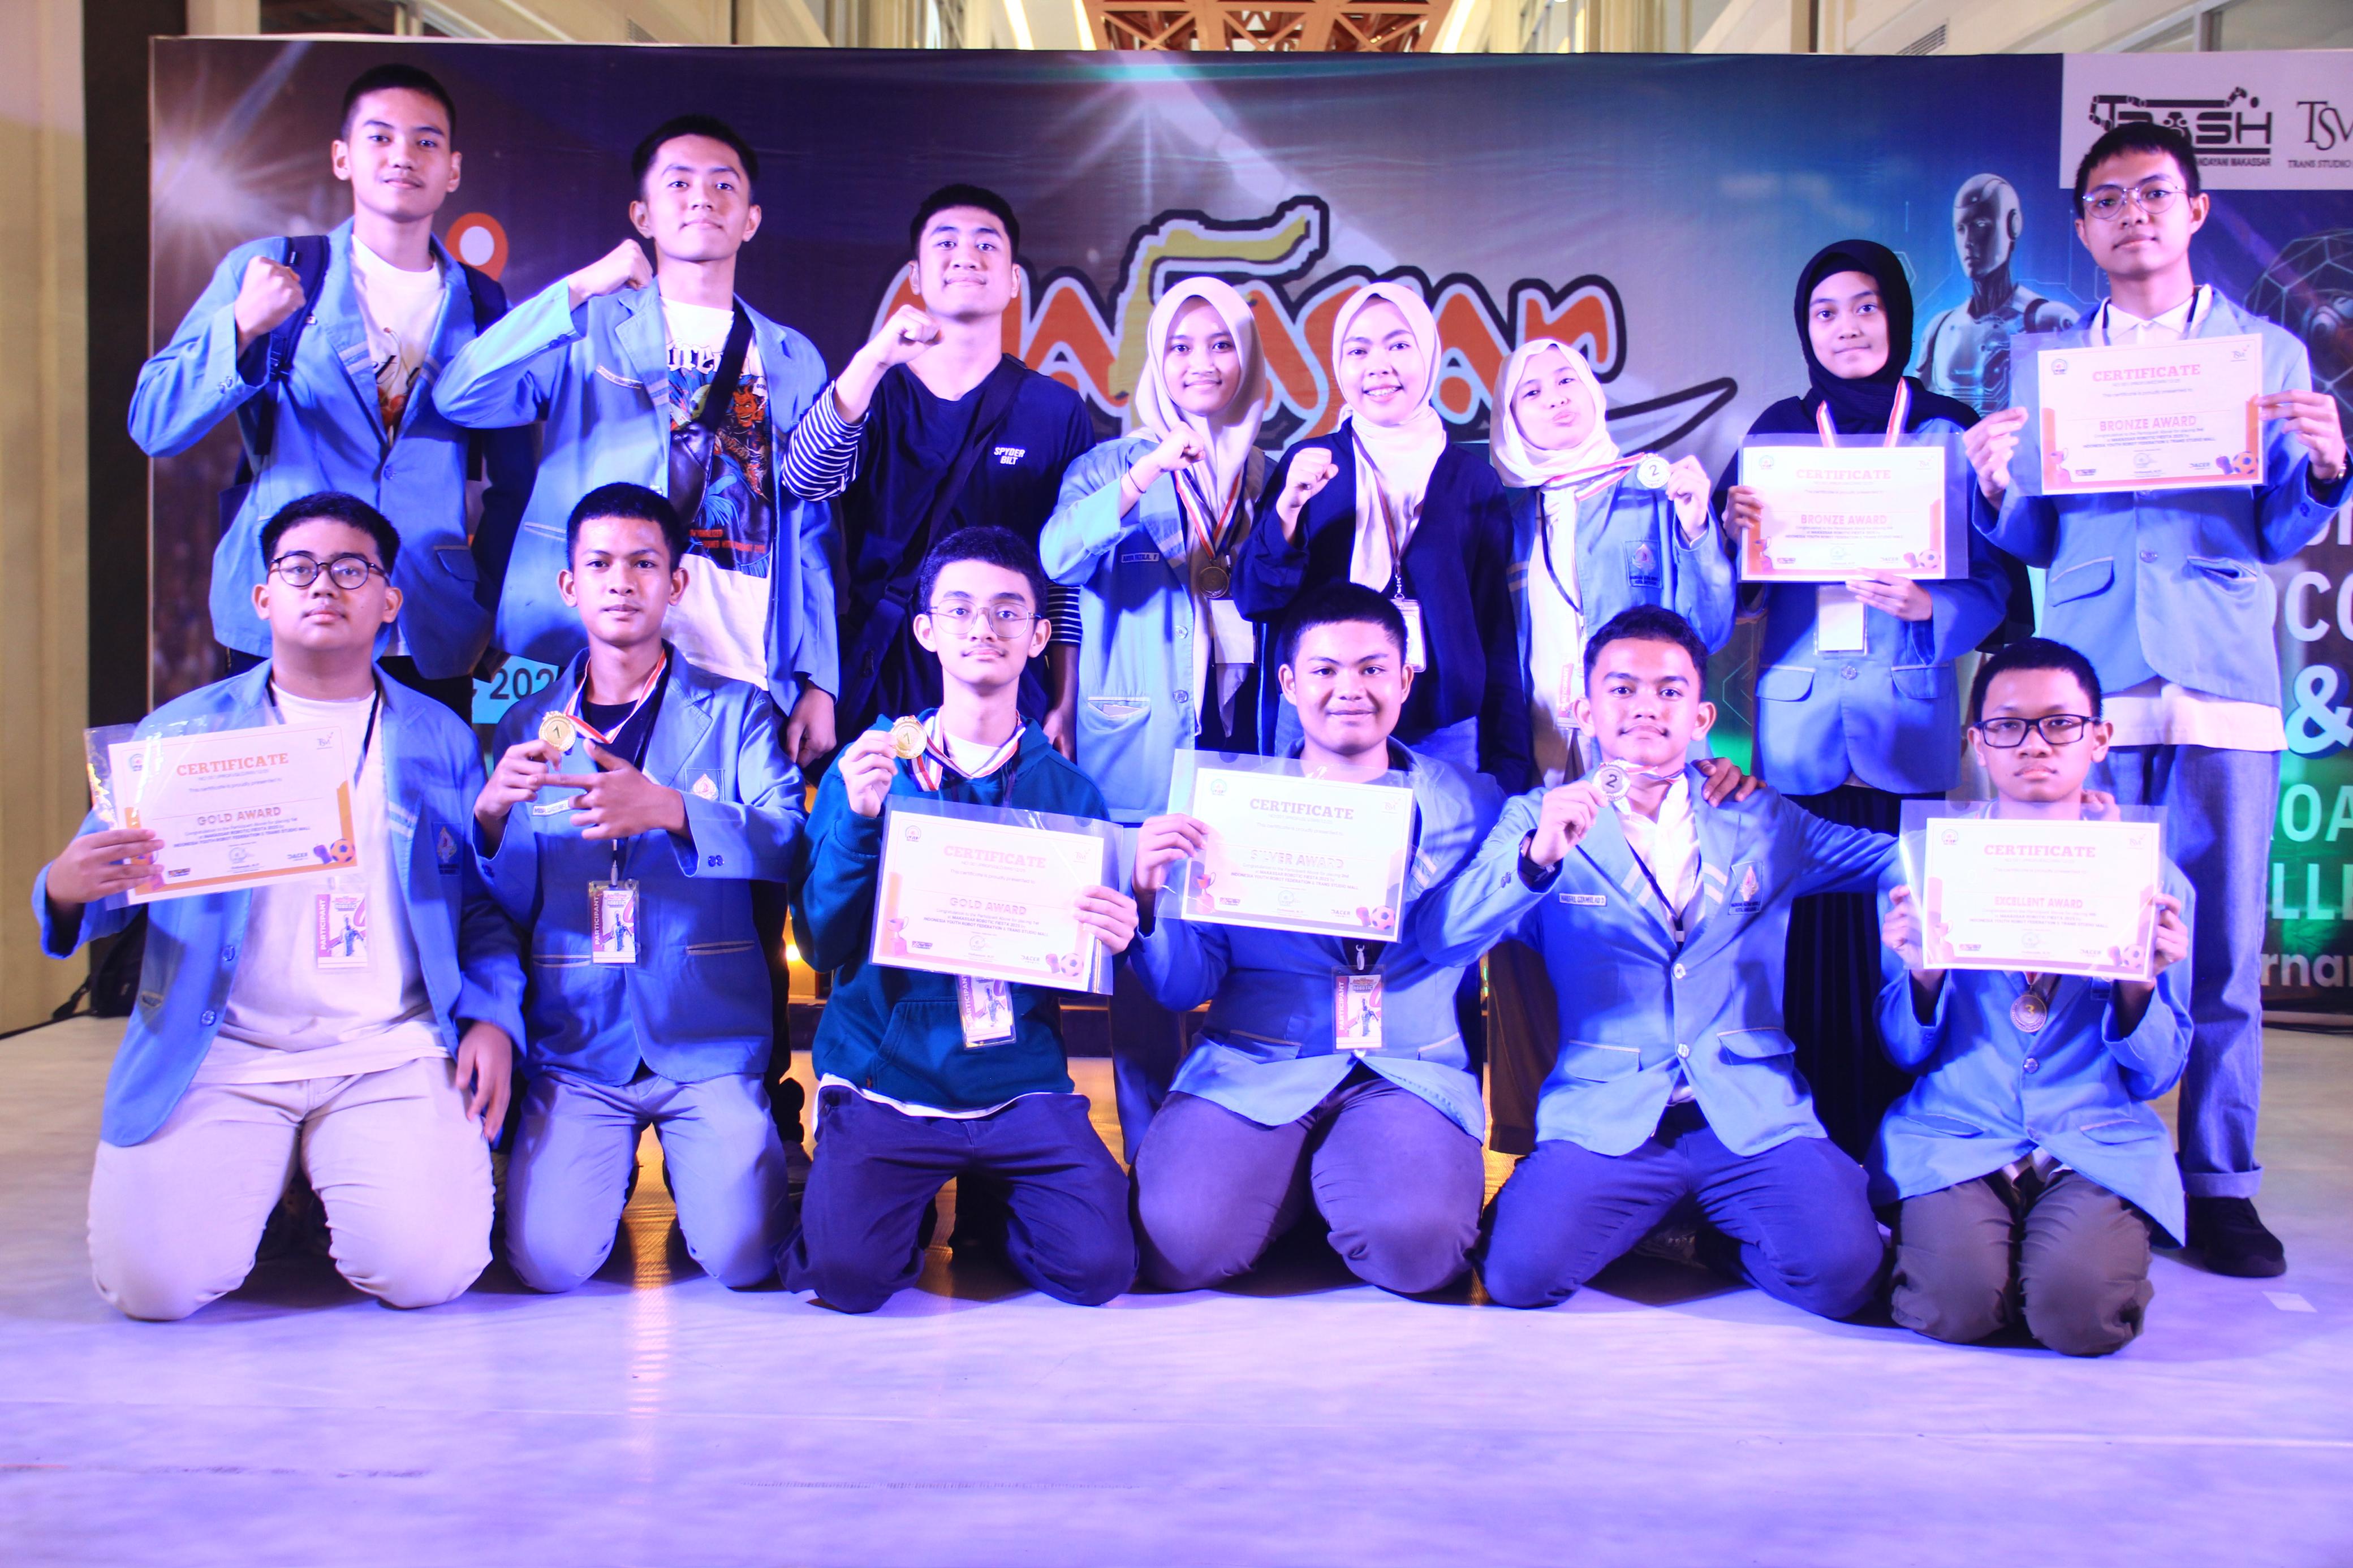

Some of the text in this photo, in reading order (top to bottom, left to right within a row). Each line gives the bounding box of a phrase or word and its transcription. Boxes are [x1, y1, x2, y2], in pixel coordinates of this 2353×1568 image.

[2092, 363, 2201, 382] CERTIFICATE
[2099, 414, 2196, 431] BRONZE AWARD
[994, 447, 1025, 457] SPYDER
[1000, 456, 1018, 465] BILT
[1649, 464, 1660, 476] 2
[1796, 469, 1891, 480] CERTIFICATE
[1800, 514, 1887, 525] BRONZE AWARD
[175, 753, 289, 775] CERTIFICATE
[1606, 774, 1618, 788] 2
[196, 806, 282, 826] GOLD AWARD
[1249, 798, 1354, 819] CERTIFICATE
[943, 845, 1046, 869] CERTIFICATE
[1983, 844, 2096, 858] CERTIFICATE
[1295, 854, 1344, 870] AWARD
[949, 896, 1027, 916] GOLD AWARD
[1994, 896, 2083, 909] EXCELLENT AWARD
